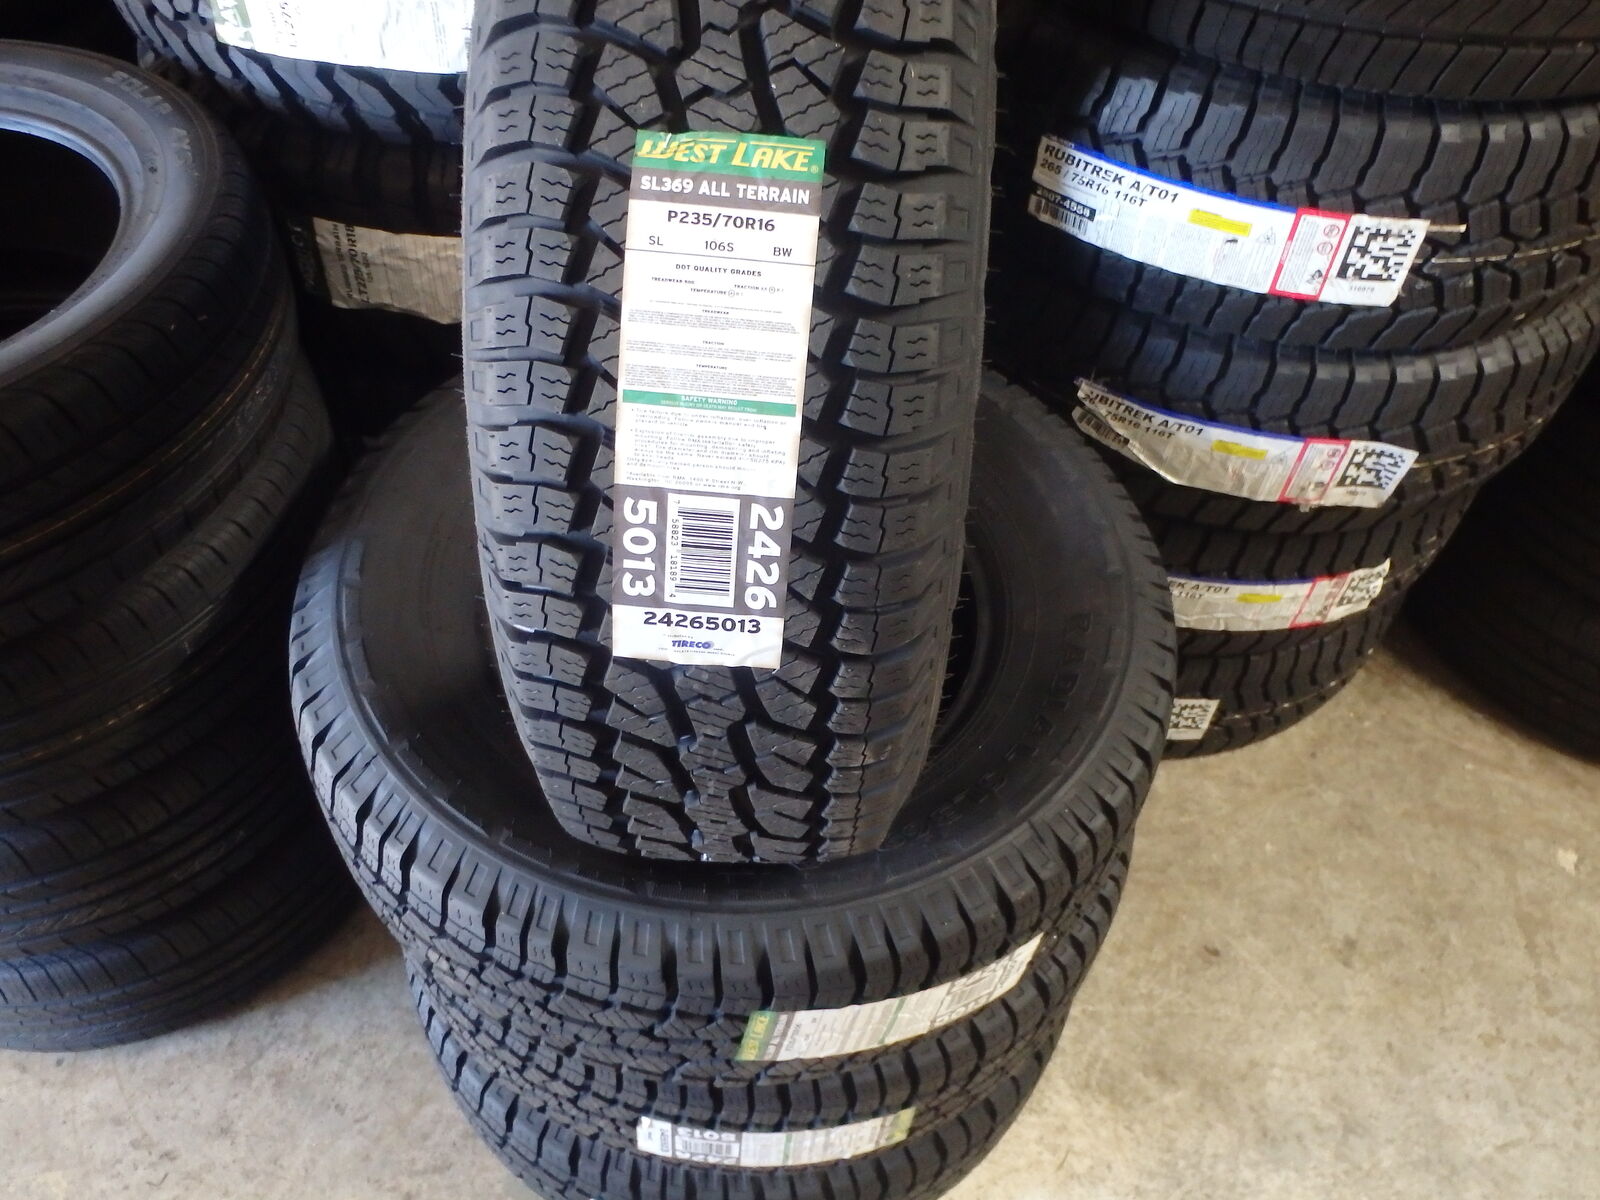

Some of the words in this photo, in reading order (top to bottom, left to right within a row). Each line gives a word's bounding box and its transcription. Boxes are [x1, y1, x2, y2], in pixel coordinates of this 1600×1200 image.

[636, 138, 728, 163] WEST
[731, 141, 816, 172] LAKE
[1043, 143, 1126, 186] RUBITREK
[1129, 179, 1180, 204] A/T01
[639, 175, 694, 195] SL369
[698, 179, 730, 197] ALL
[736, 184, 810, 206] TERRAIN
[666, 209, 776, 233] P235/70R16
[648, 235, 664, 247] SL
[704, 240, 735, 253] 106S
[773, 246, 793, 257] BW
[675, 263, 690, 271] DOT
[694, 266, 728, 274] QUALITY
[730, 269, 762, 278] GRADES
[621, 495, 659, 598] 5013
[744, 502, 786, 611] 2426
[642, 610, 762, 634] 24265013
[671, 639, 713, 650] TIRECO
